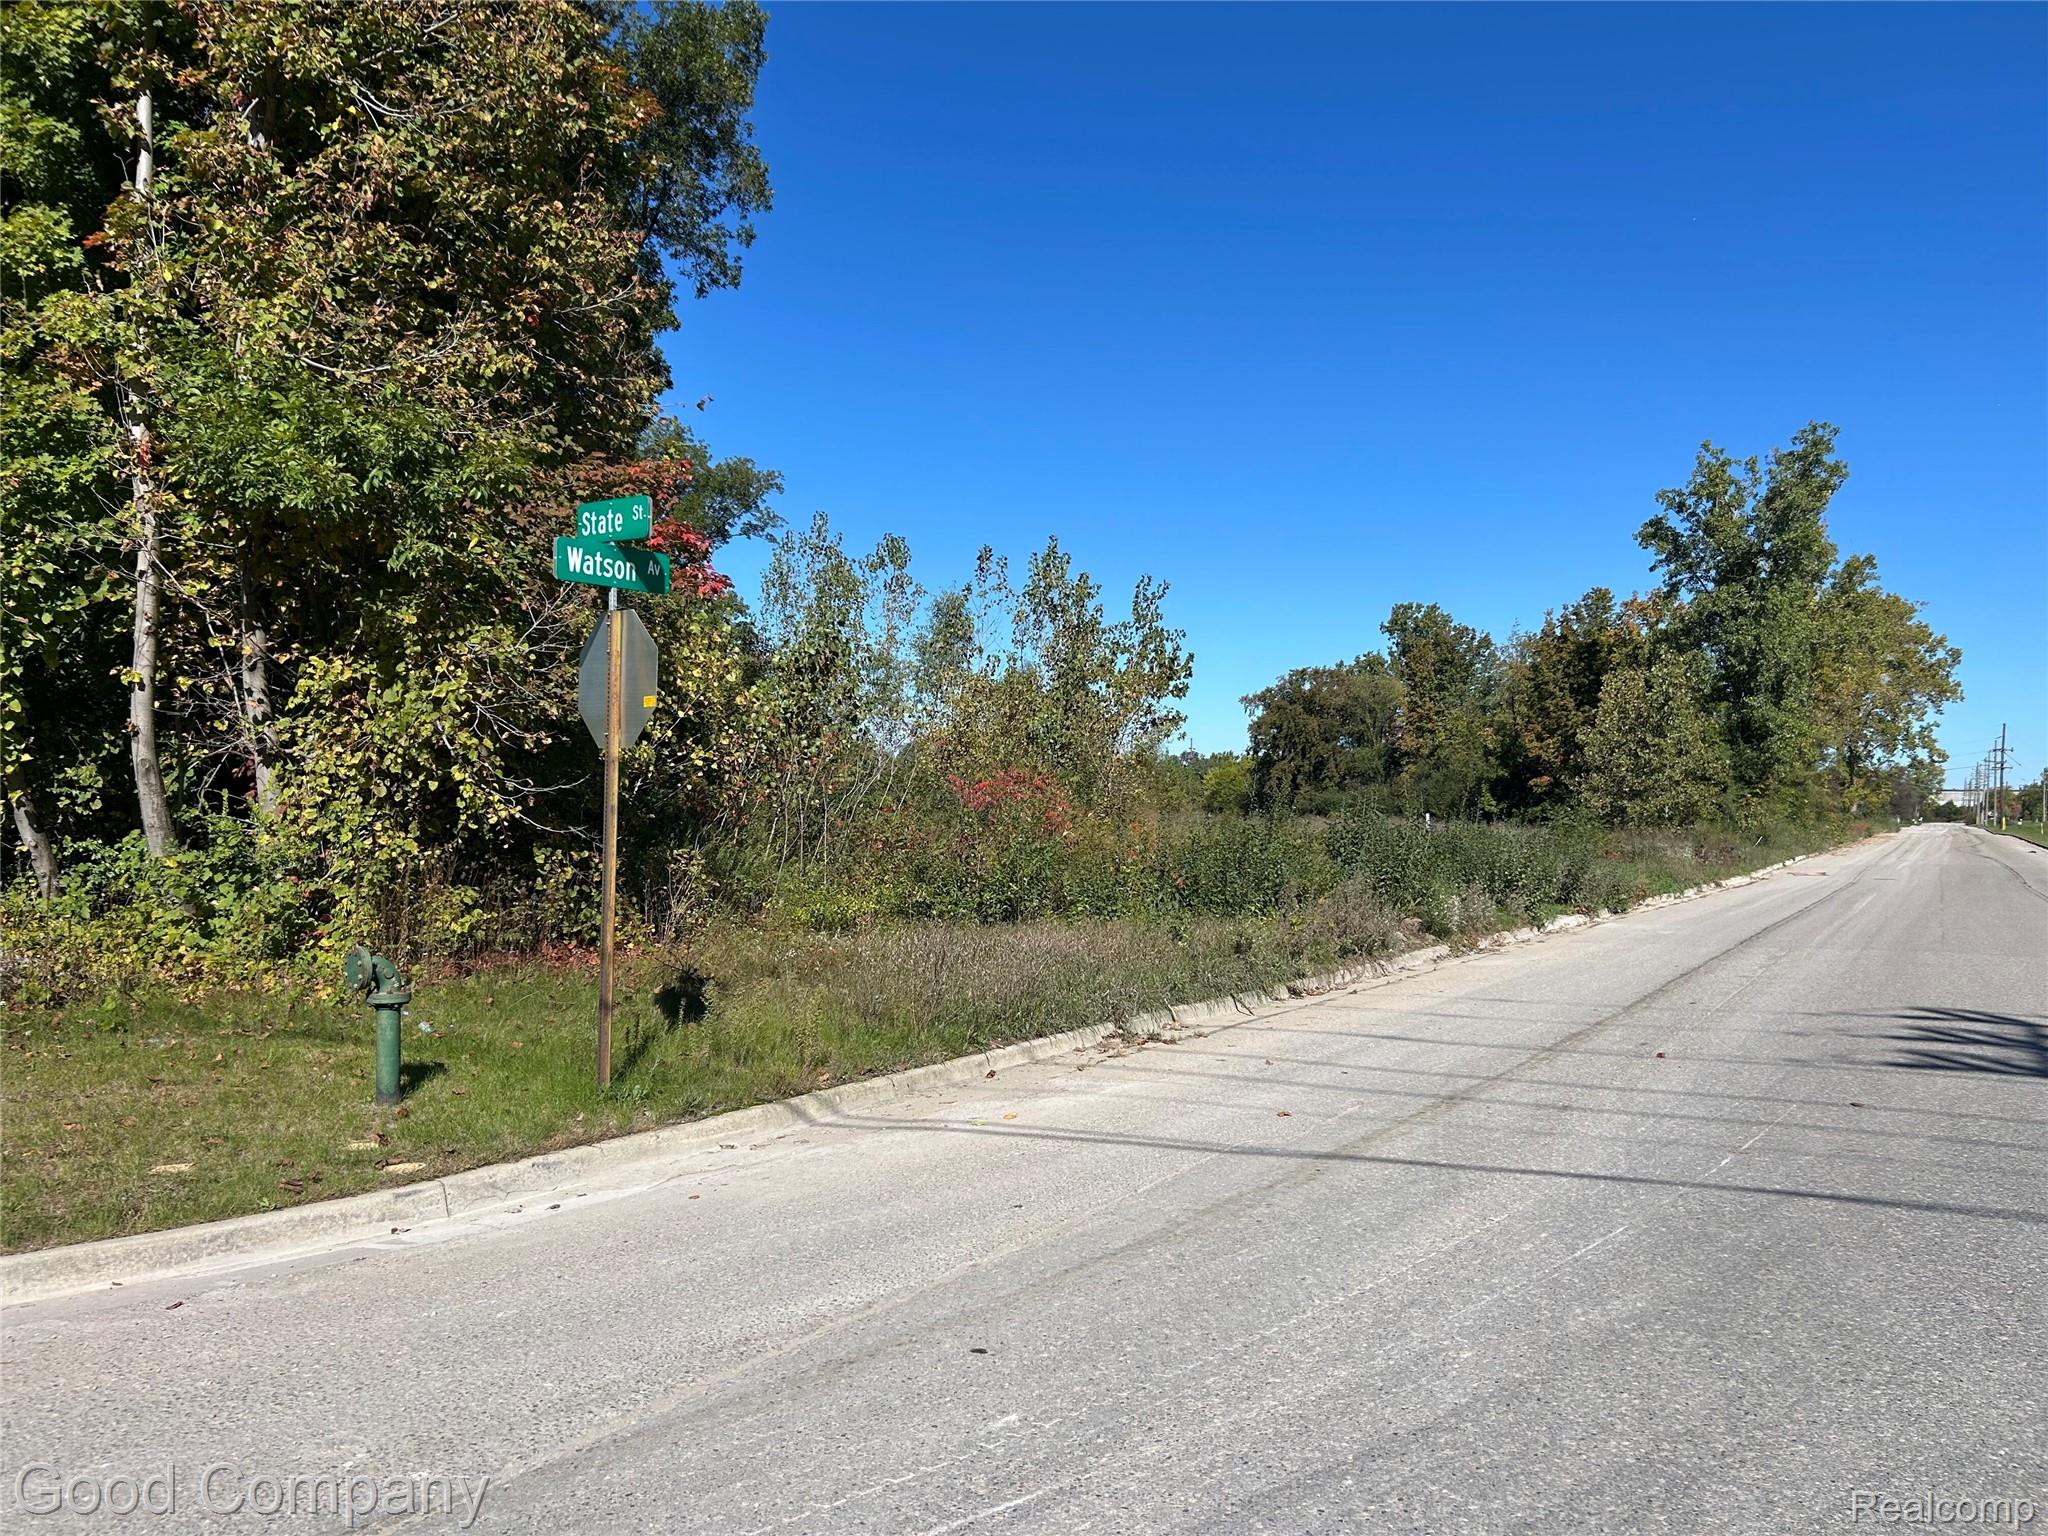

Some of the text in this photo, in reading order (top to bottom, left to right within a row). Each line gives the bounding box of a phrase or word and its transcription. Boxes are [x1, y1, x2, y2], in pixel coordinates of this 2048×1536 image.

[581, 505, 643, 536] State St
[567, 546, 660, 581] Watson Av
